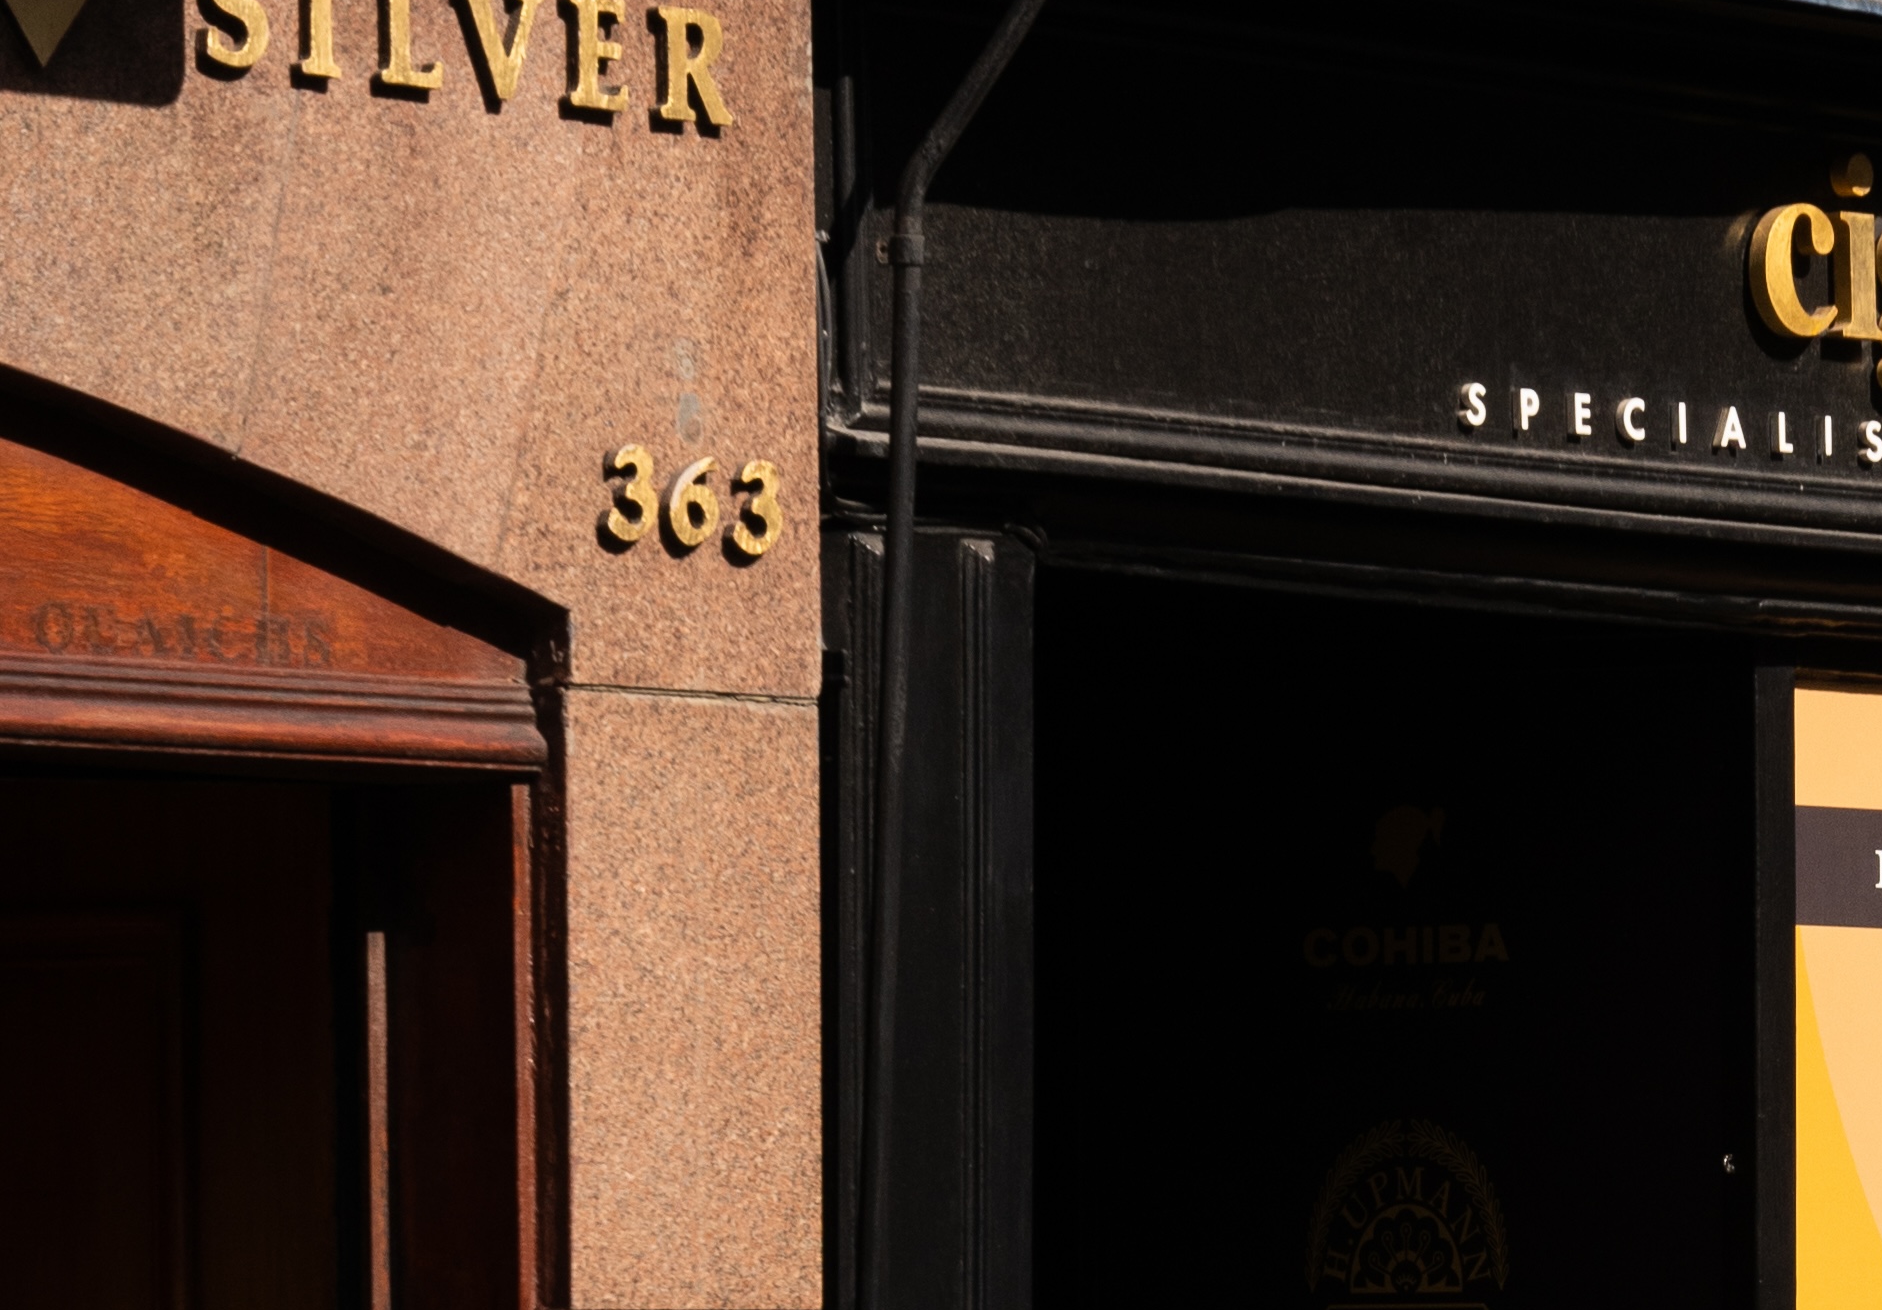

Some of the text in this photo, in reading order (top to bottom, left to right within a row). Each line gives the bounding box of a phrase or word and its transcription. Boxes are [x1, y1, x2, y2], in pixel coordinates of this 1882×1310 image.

[606, 443, 783, 556] 363
[1303, 923, 1510, 968] COHIBA
[1340, 1165, 1491, 1282] UPMANN
